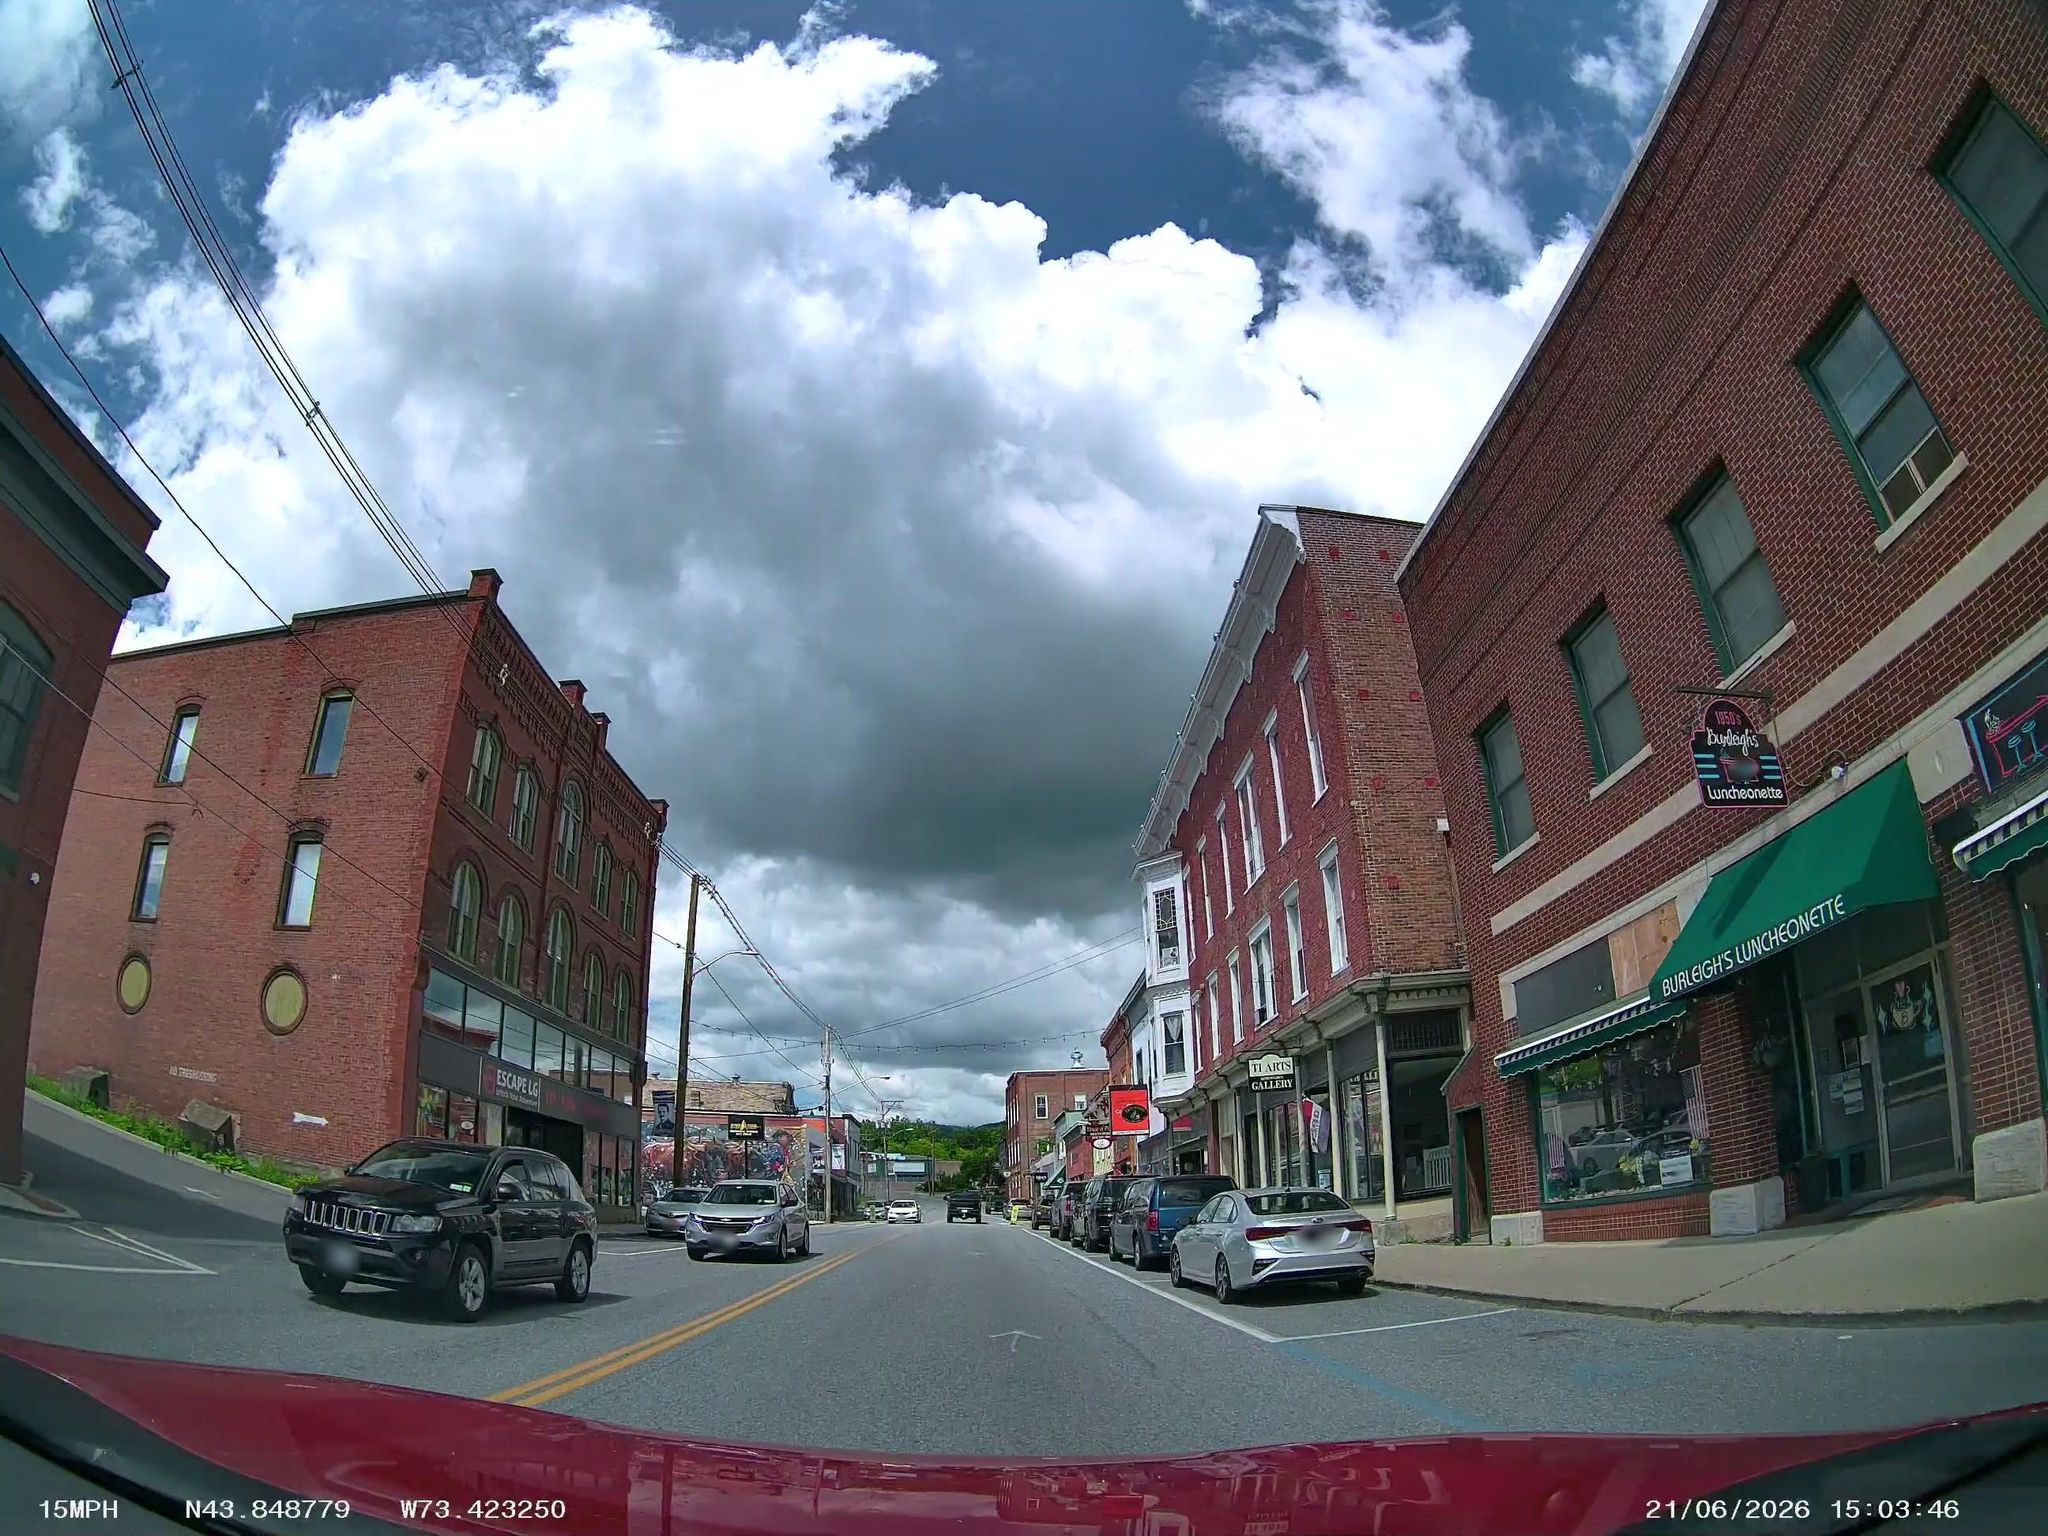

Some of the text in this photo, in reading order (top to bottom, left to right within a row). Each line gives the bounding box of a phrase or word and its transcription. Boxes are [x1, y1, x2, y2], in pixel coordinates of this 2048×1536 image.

[1714, 710, 1742, 726] 1950's
[1706, 726, 1759, 757] Burleigh's
[1707, 784, 1783, 800] Luncheonette
[1662, 894, 1846, 997] BURLEIGH'S LUNCHEONETTE
[1265, 1061, 1291, 1072] ARTS
[497, 1069, 539, 1097] ESCAPE LG
[1252, 1079, 1293, 1090] GALLERY
